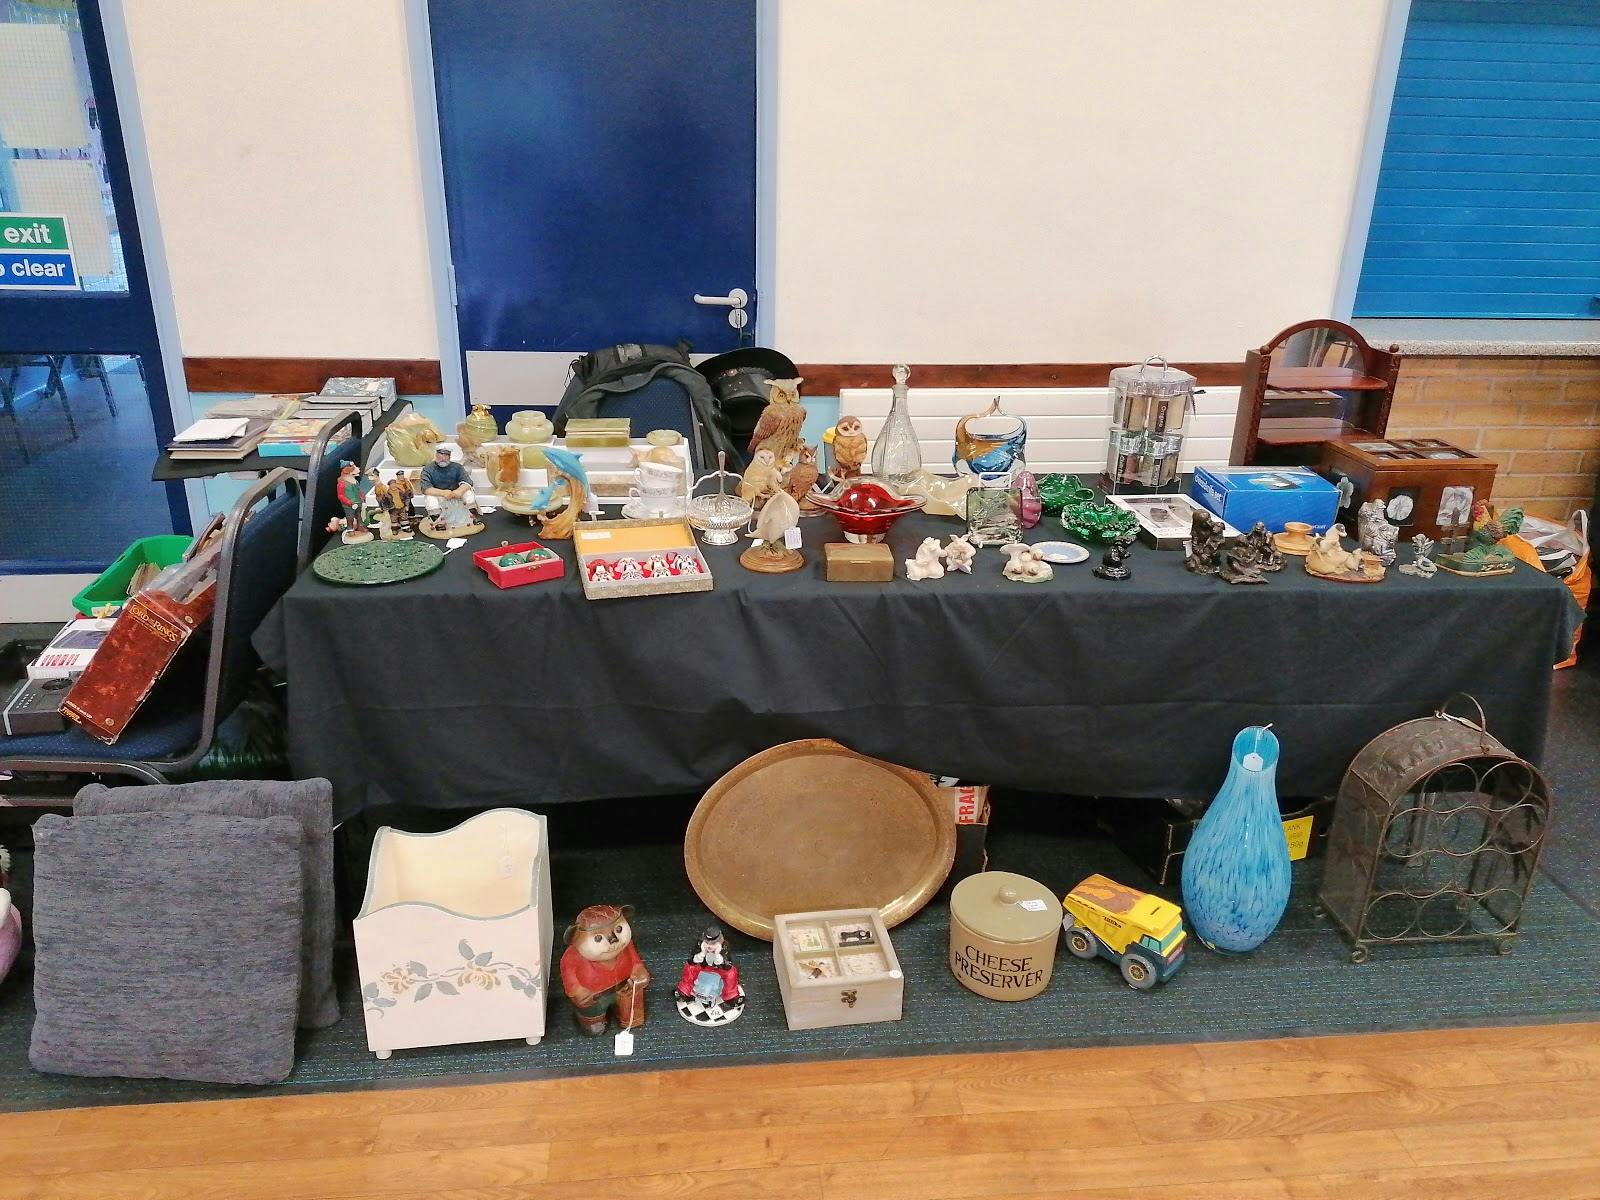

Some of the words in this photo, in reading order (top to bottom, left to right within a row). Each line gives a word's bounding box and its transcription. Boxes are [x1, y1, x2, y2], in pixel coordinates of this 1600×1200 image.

[4, 223, 52, 243] exit
[11, 259, 66, 277] clear
[129, 604, 150, 622] LORD
[153, 620, 178, 642] RINGS
[955, 951, 1043, 989] PRESERVER
[965, 945, 1033, 973] CHEESE
